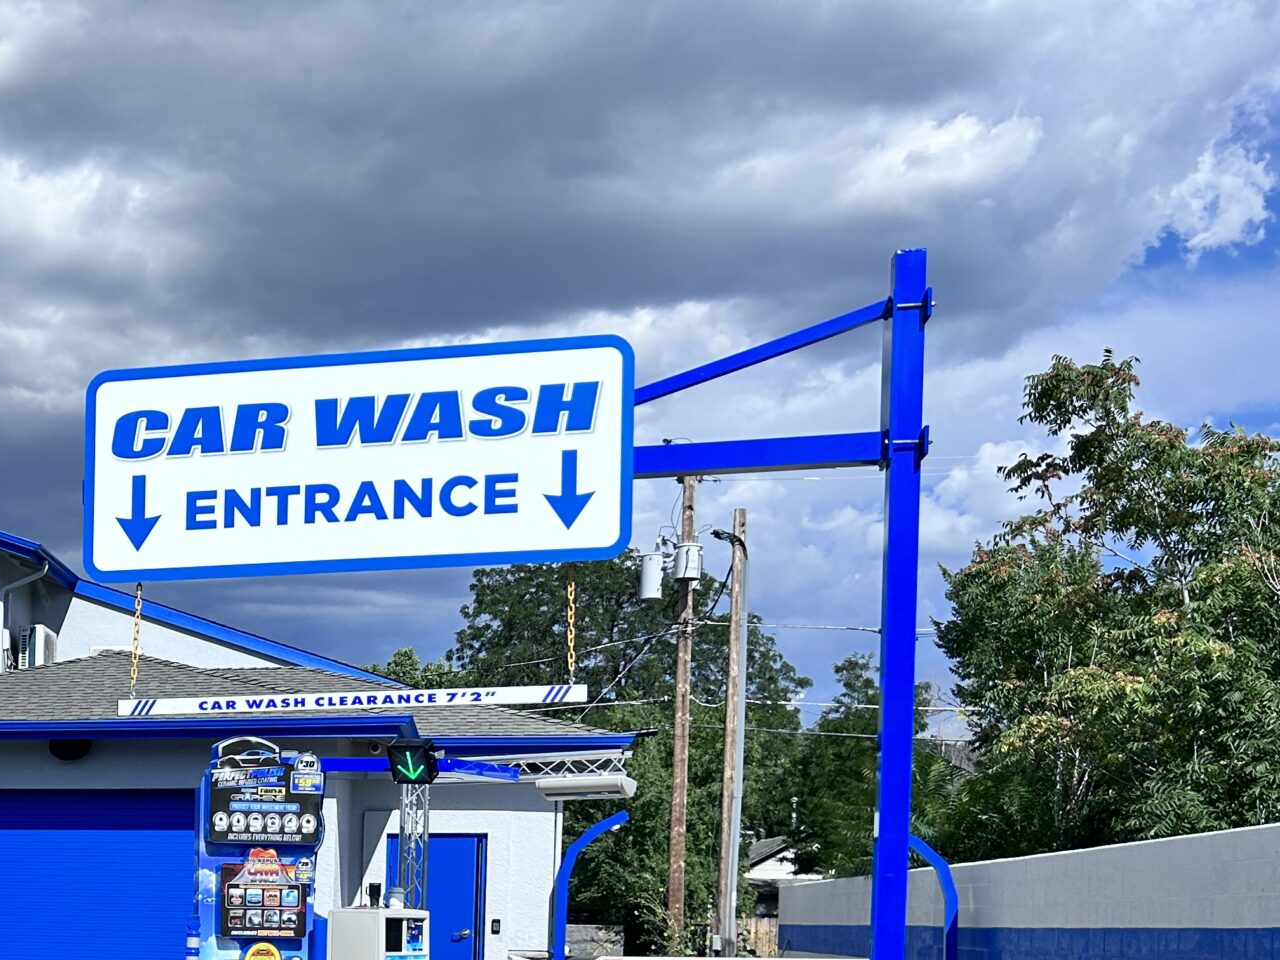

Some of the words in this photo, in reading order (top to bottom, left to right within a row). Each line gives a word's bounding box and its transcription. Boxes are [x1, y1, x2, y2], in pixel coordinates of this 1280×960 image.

[111, 402, 291, 460] CAR
[314, 381, 602, 448] WASH
[186, 473, 519, 530] ENTRANCE
[198, 700, 237, 711] CAR
[245, 697, 306, 709] WASH
[315, 693, 437, 707] CLEARANCE
[300, 760, 315, 768] $30
